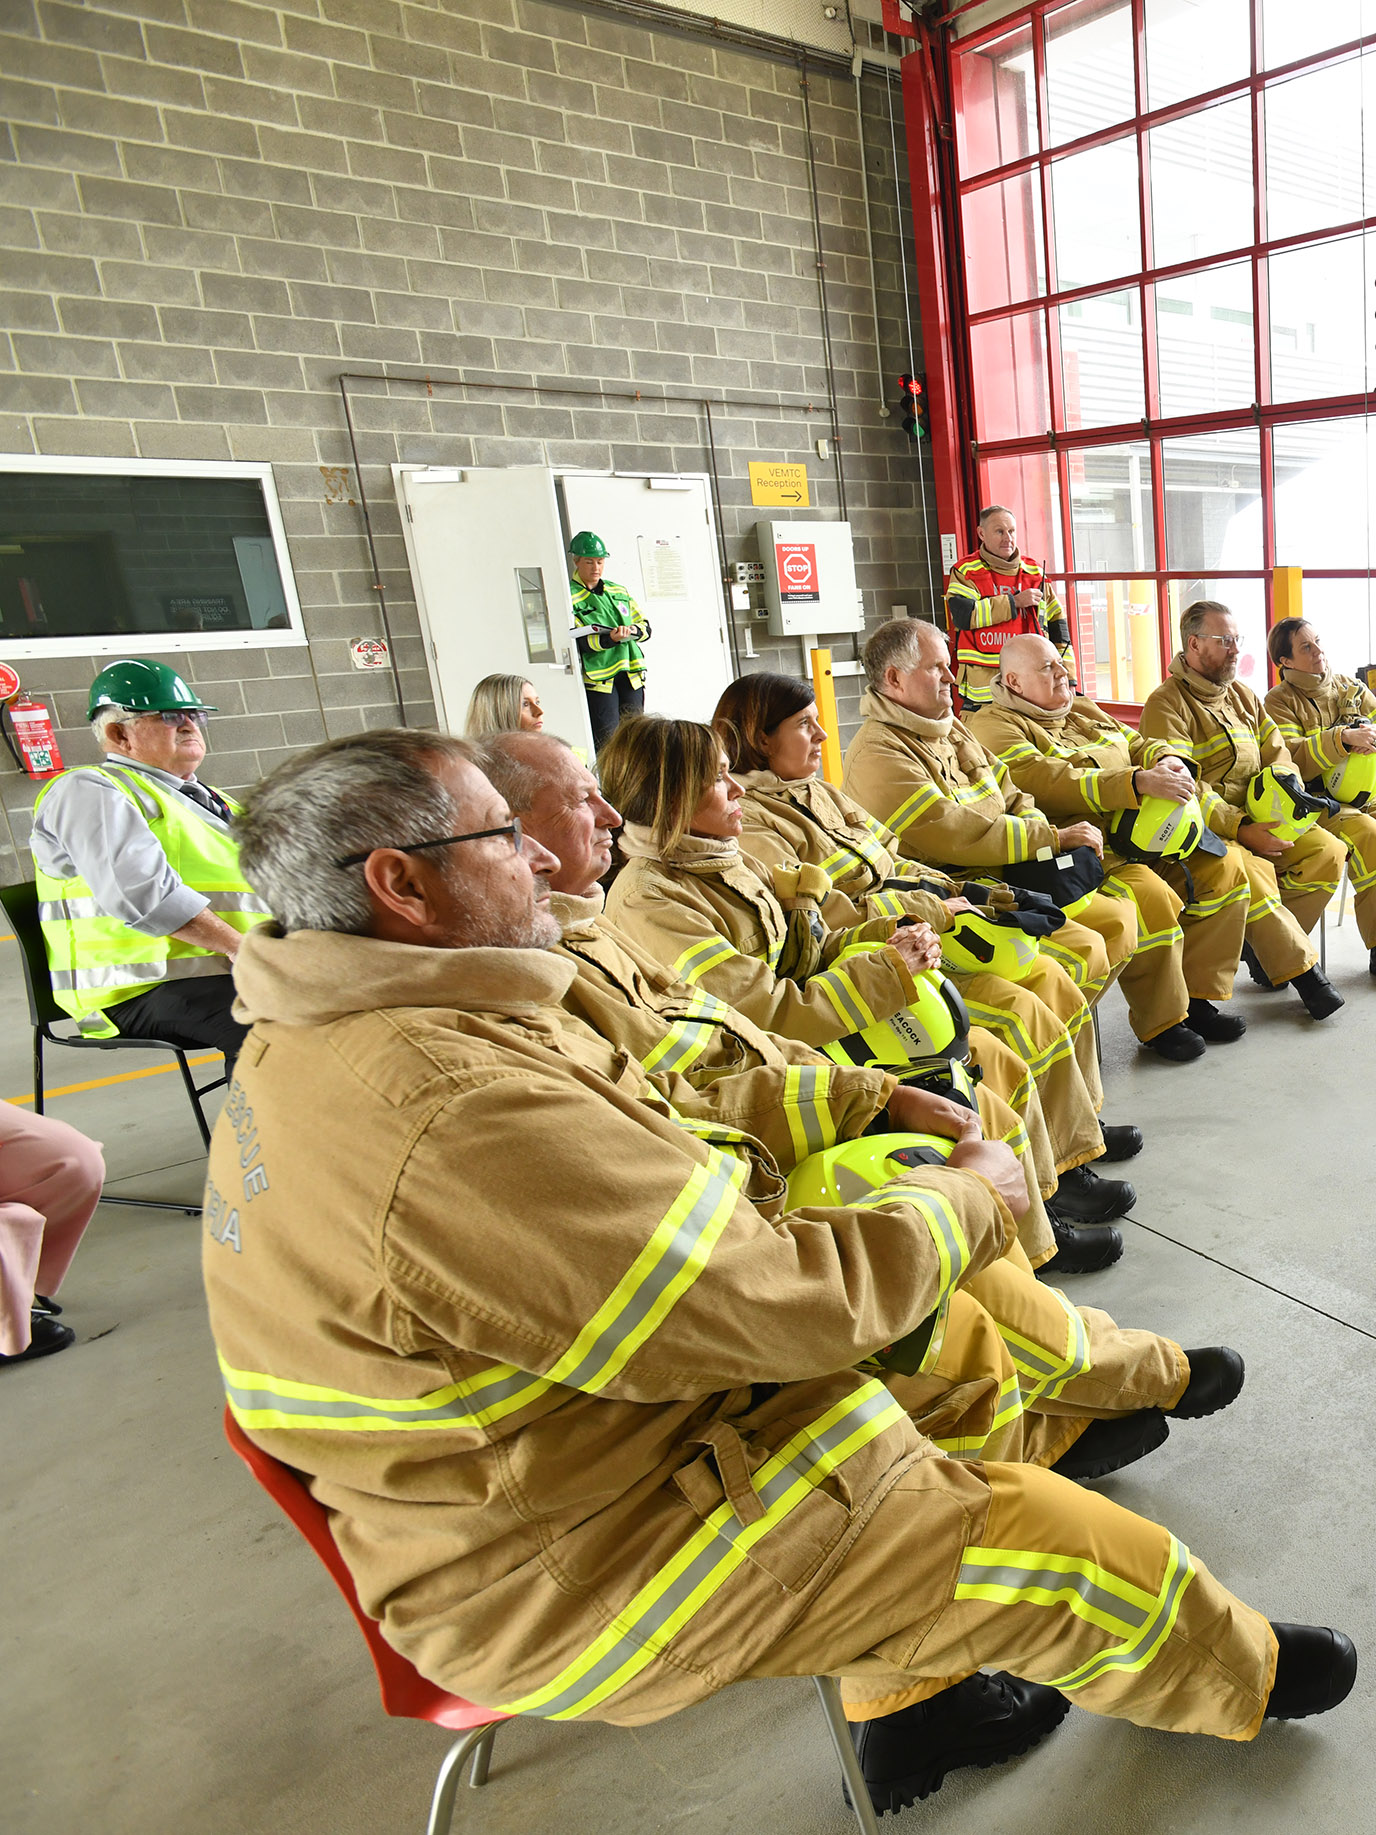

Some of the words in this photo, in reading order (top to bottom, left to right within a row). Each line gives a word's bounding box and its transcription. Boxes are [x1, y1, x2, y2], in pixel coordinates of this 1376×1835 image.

[769, 468, 801, 478] VEMTC
[756, 478, 802, 488] Reception
[1159, 823, 1173, 841] SCOTT
[894, 1012, 922, 1046] EACOCK
